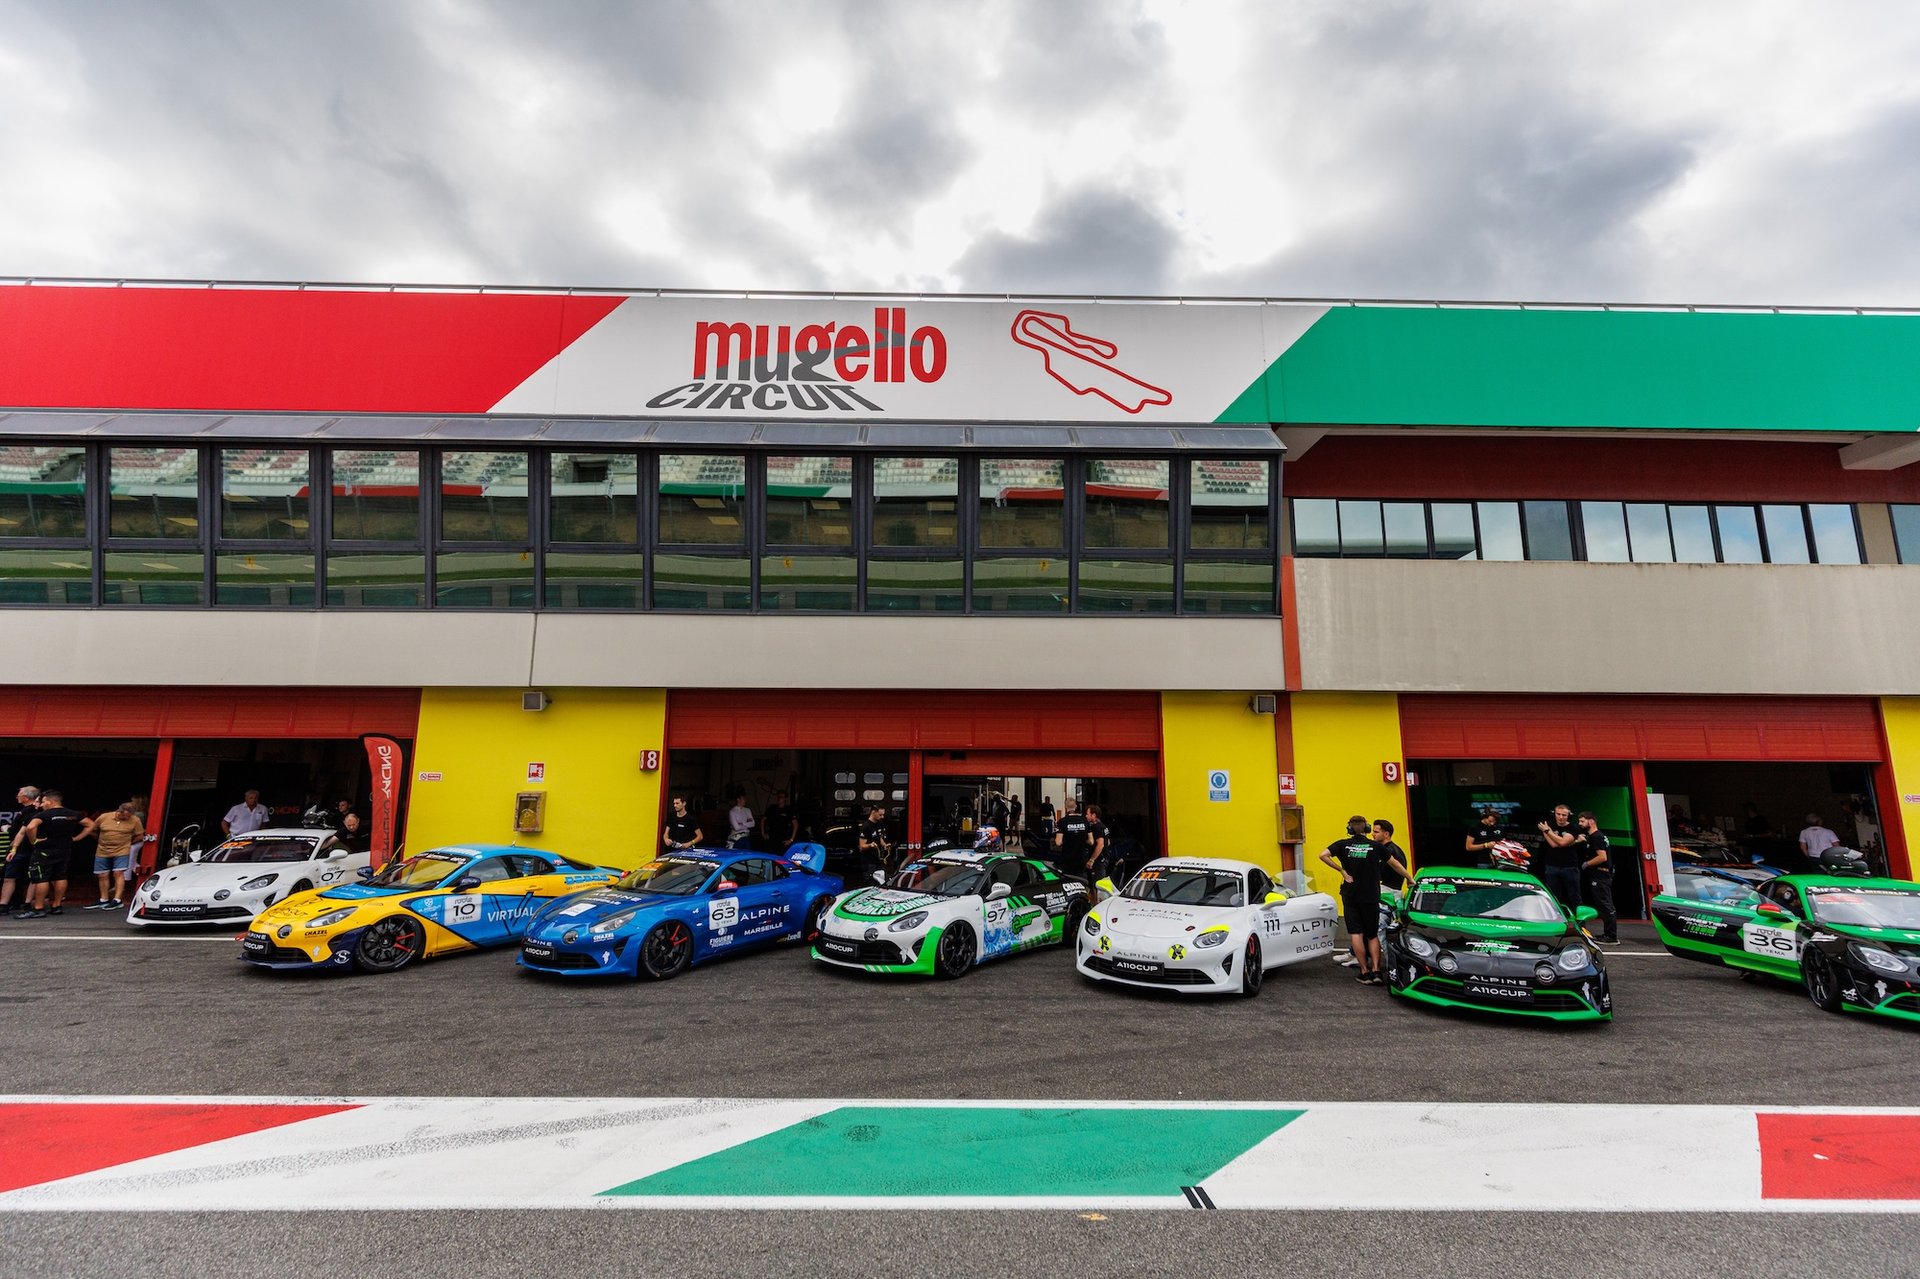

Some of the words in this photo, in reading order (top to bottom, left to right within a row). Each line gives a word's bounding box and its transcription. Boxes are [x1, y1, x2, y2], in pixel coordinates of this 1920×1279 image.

[693, 307, 947, 384] mugello
[645, 382, 885, 411] CIRCUIT
[647, 751, 657, 769] 8
[1385, 763, 1398, 781] 9
[321, 870, 345, 882] 07
[453, 903, 475, 917] 10
[487, 906, 535, 922] VIRTUAL
[712, 907, 736, 921] 63
[740, 904, 790, 922] ALPINE
[987, 907, 1007, 922] 97
[1263, 919, 1280, 932] 111
[1678, 915, 1728, 928] FORESTIER
[744, 922, 783, 936] MARSEILLE
[1757, 928, 1782, 937] roole
[527, 937, 553, 946] ALPINE
[825, 942, 854, 953] A110CUP
[1749, 932, 1793, 951] 36
[525, 947, 551, 957] A110CUP
[1117, 952, 1158, 960] ALPINE
[1117, 962, 1158, 971] A110CUP
[1470, 975, 1528, 986] ALPINE
[1472, 986, 1527, 998] A110CUP
